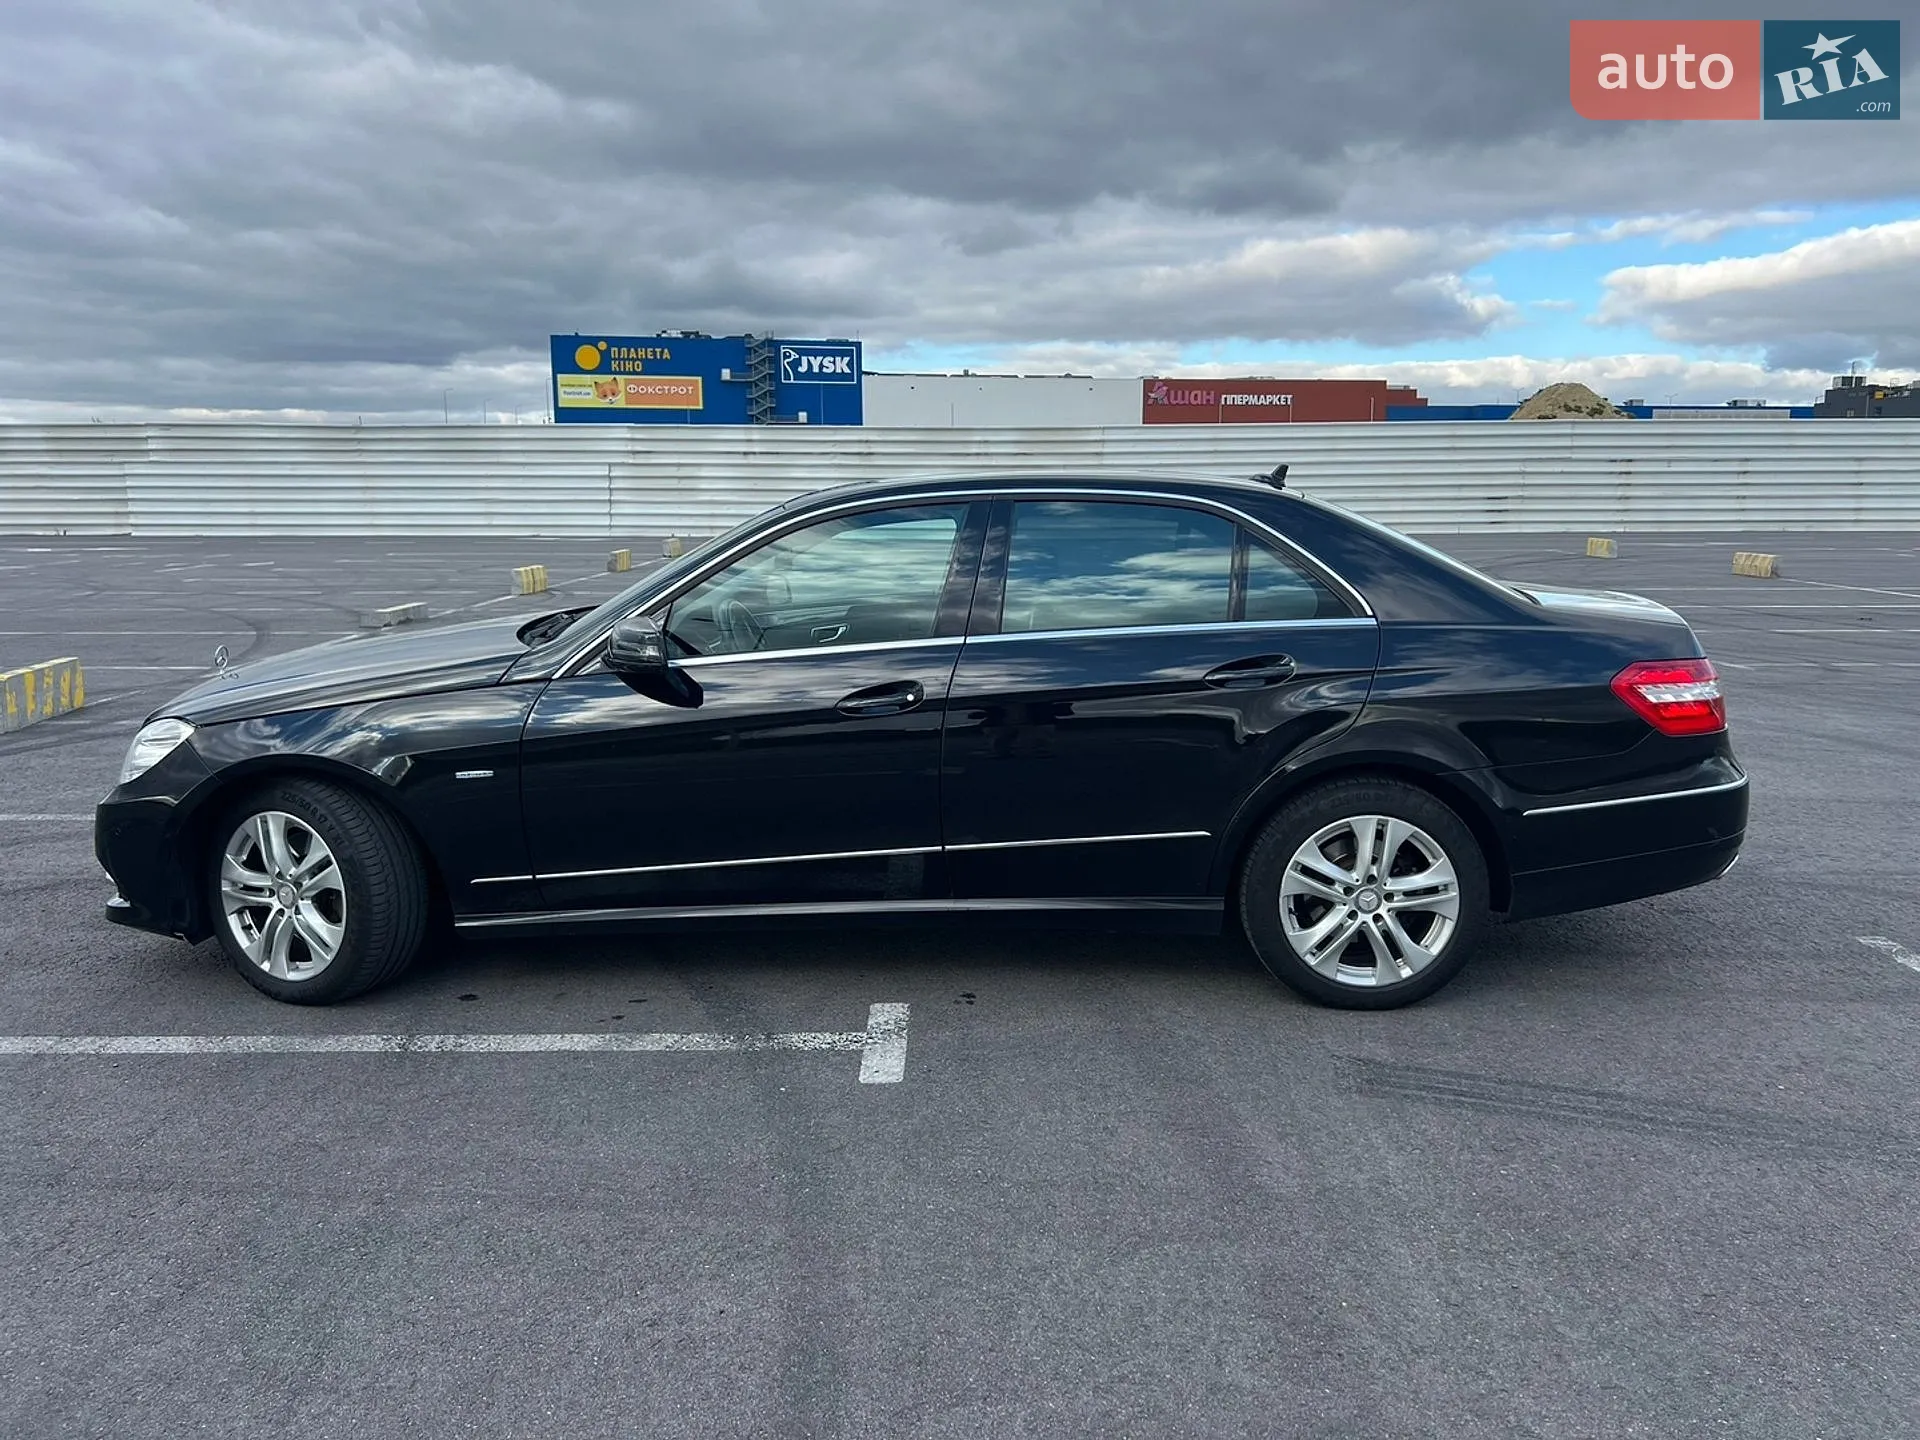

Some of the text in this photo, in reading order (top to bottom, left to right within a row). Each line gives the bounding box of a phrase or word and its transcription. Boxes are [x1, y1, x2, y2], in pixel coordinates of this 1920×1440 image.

[610, 347, 671, 360] ПЛАНЕТА
[611, 360, 642, 372] КІНО
[797, 355, 852, 373] JYSK
[626, 384, 694, 395] ФОКСТРОТ
[1221, 394, 1293, 405] ГІПЕРМАРКЕТ
